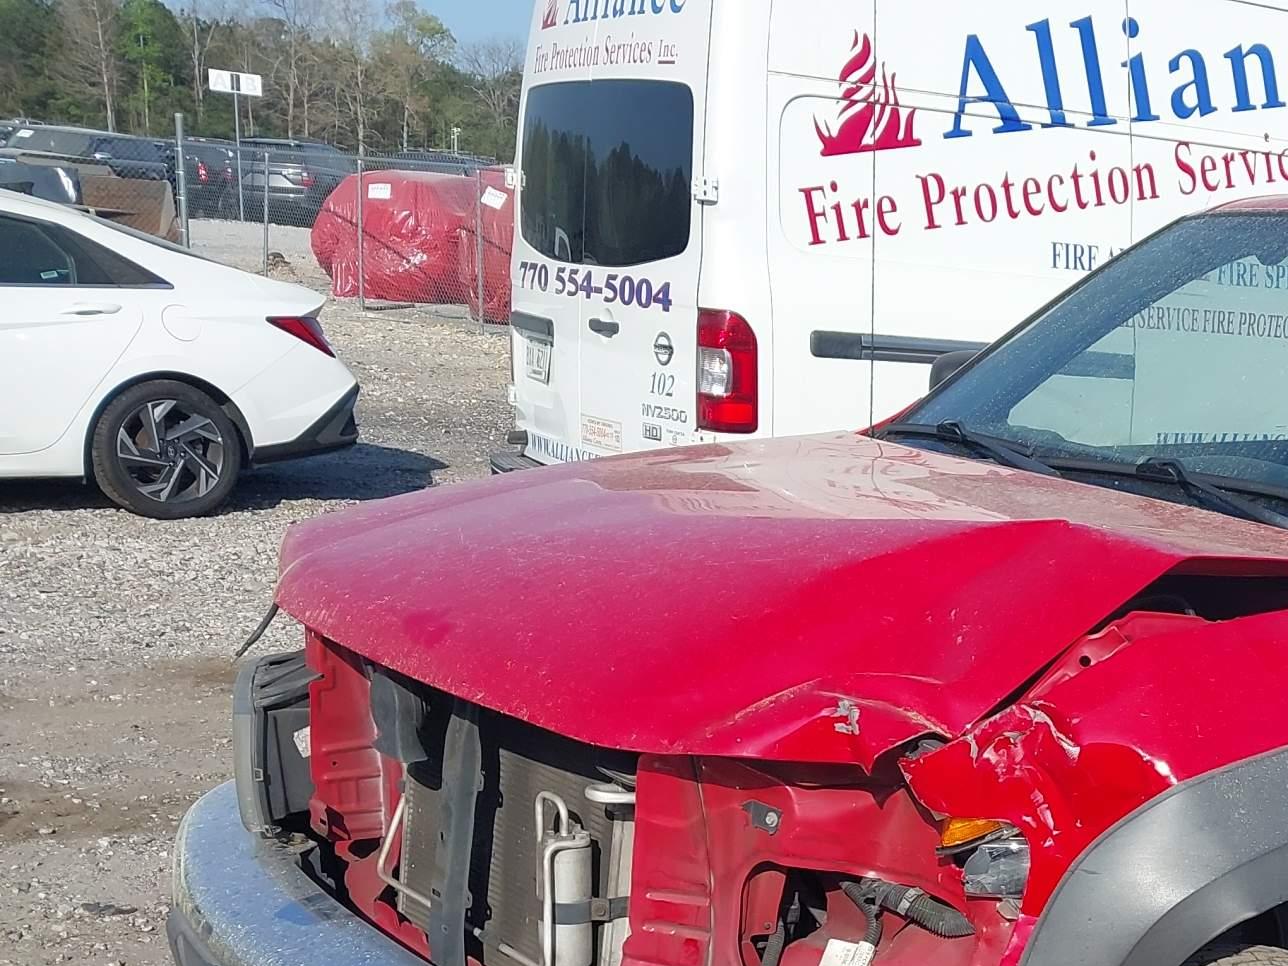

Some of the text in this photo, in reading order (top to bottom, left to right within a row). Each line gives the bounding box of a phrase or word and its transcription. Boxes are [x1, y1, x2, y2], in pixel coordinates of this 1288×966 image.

[533, 32, 679, 74] Fire Protection Services Inc.
[798, 179, 902, 246] Fire
[915, 149, 1160, 230] Protection
[1050, 241, 1100, 272] FIRE
[519, 261, 673, 313] 770 554-5004
[1216, 261, 1260, 288] FIRE
[1138, 305, 1201, 333] SERVICE
[1202, 309, 1235, 336] FIRE
[650, 371, 675, 397] 102
[641, 403, 688, 424] NV2500
